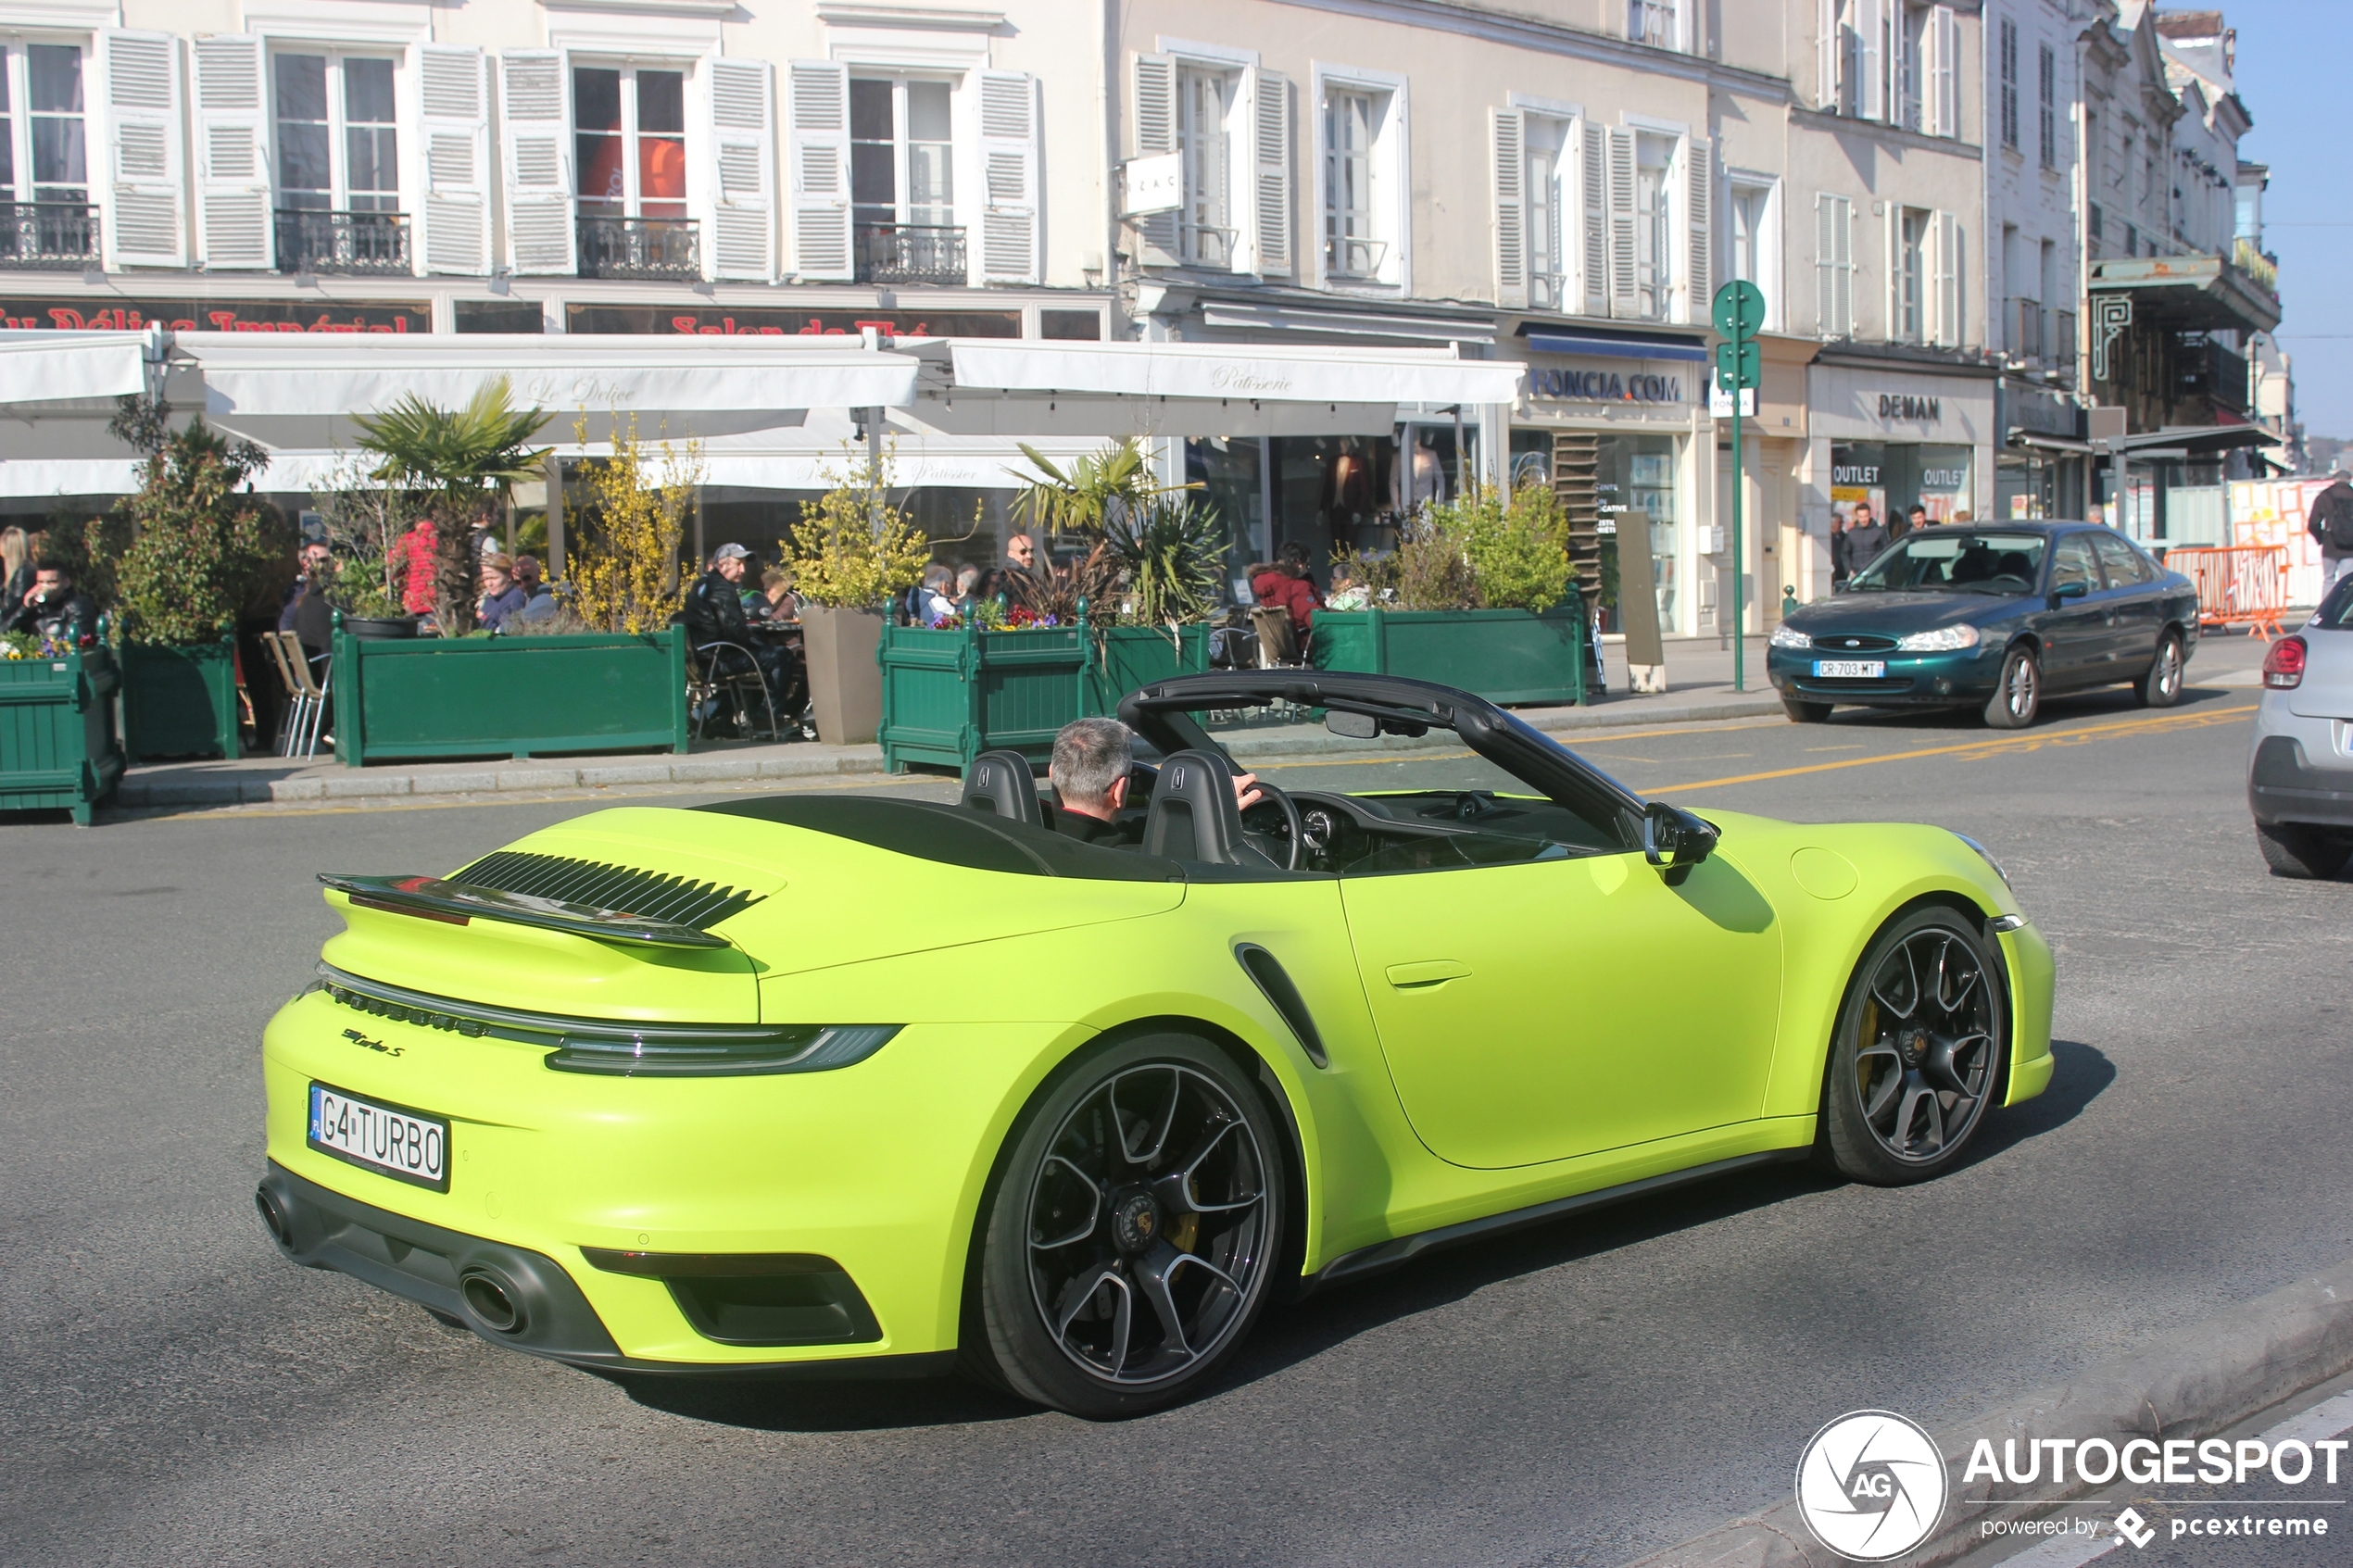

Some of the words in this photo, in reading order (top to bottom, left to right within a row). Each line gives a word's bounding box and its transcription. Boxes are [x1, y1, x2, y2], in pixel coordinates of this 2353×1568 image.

[0, 308, 37, 329] u
[1530, 369, 1680, 401] FONCIA.COM
[1879, 395, 1939, 420] DEMAN
[1833, 466, 1880, 483] OUTLET
[359, 1106, 442, 1174] TURBO
